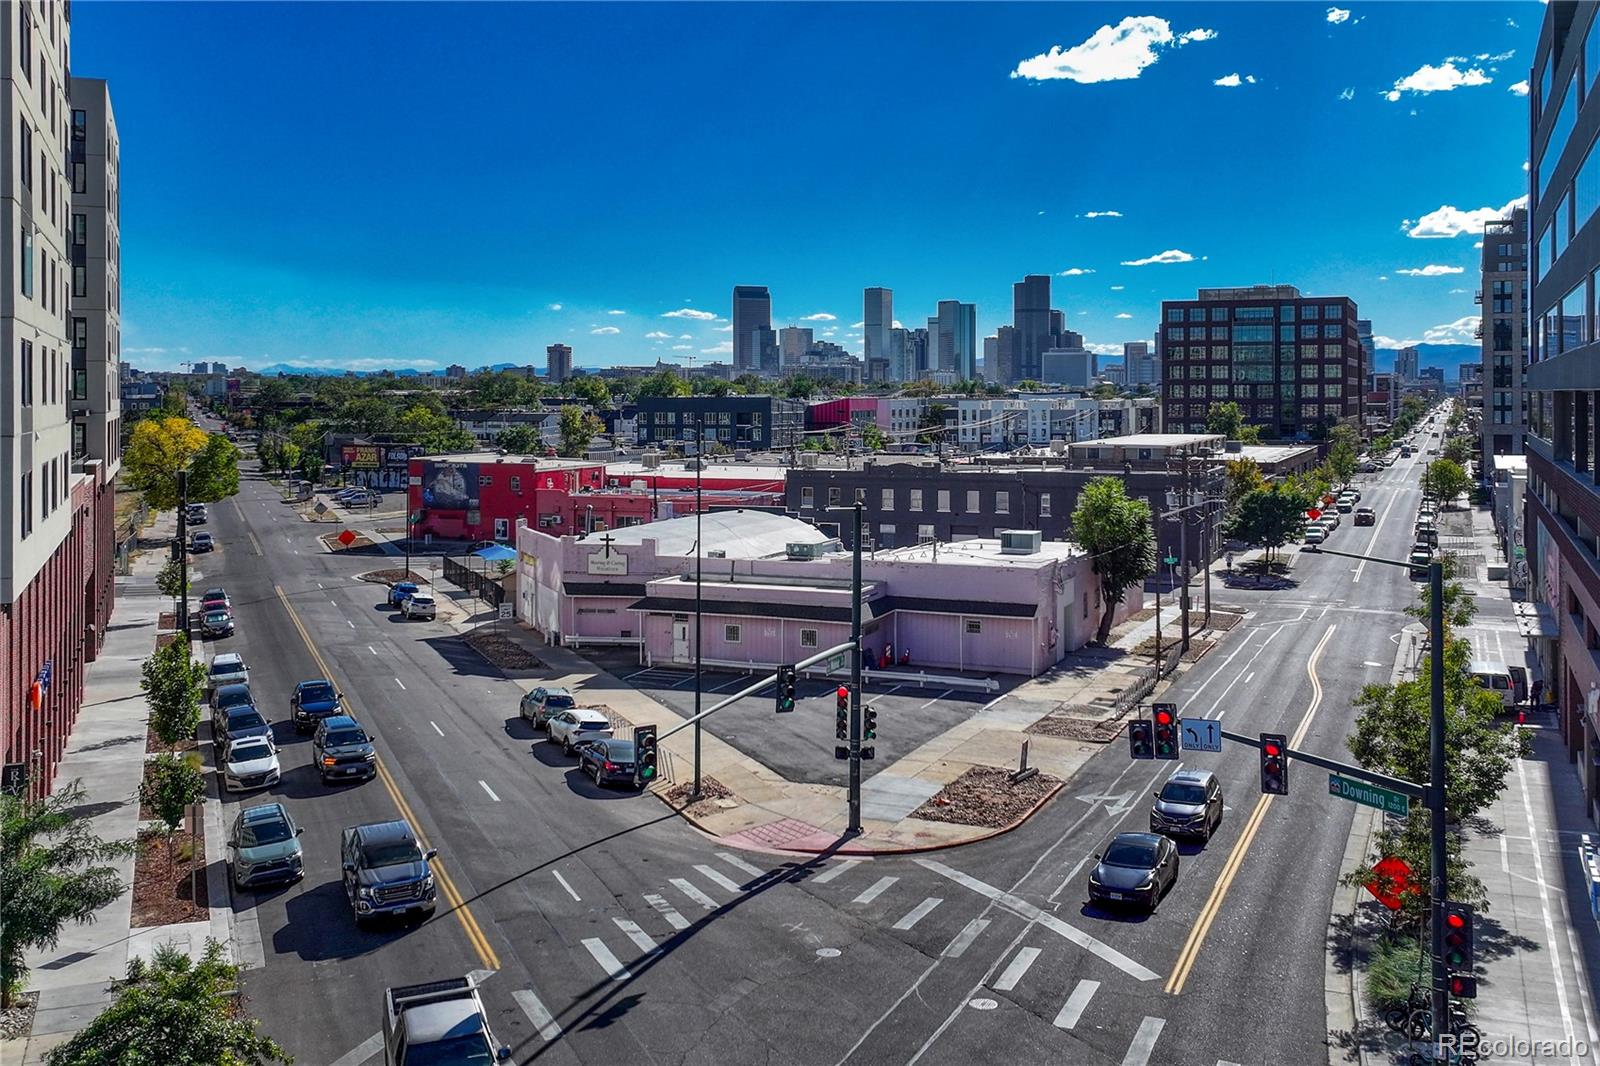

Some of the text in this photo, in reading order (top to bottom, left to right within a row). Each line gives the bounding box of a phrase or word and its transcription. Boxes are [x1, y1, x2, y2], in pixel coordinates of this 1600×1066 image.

[355, 453, 377, 461] AZAR
[1342, 781, 1385, 808] Downing
[1387, 801, 1401, 811] 1200
